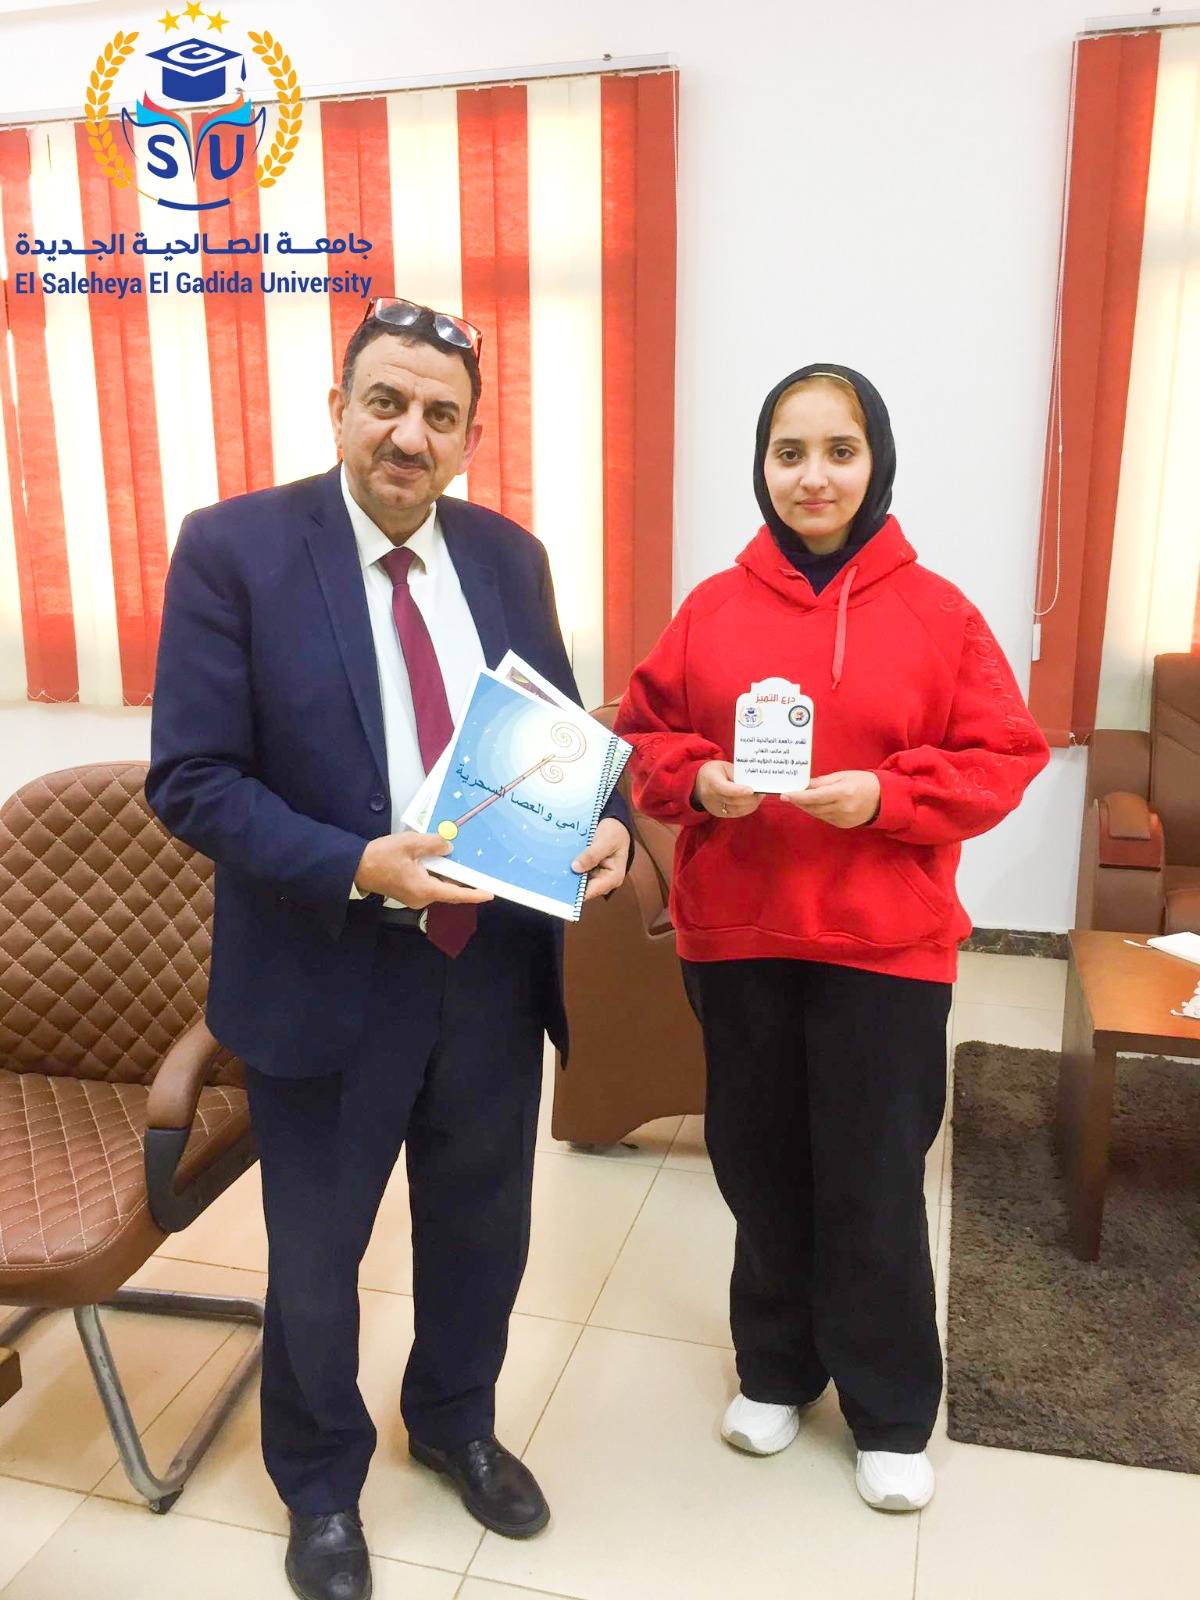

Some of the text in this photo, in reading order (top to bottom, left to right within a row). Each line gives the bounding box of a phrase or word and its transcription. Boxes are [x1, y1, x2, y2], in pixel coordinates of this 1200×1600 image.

[755, 693, 796, 705] درع التميز
[455, 763, 506, 798] السحرية
[555, 818, 589, 837] رامي
